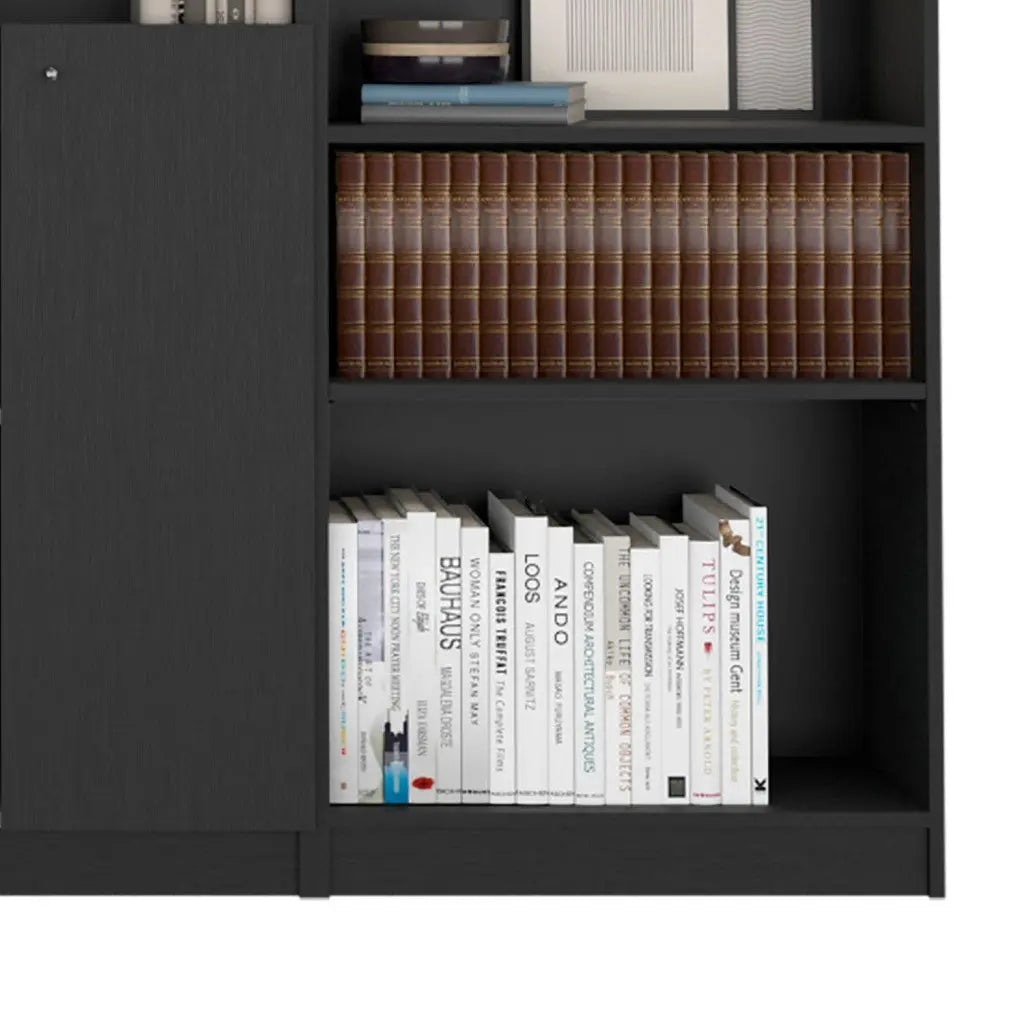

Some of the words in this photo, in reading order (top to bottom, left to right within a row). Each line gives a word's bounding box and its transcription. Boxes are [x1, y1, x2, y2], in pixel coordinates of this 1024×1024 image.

[390, 534, 401, 551] THE
[390, 552, 401, 571] NEW
[619, 548, 631, 568] THE
[390, 573, 401, 594] YORK
[470, 557, 481, 608] WOMAN
[524, 553, 540, 604] LOOS
[755, 539, 766, 597] CENTURY
[390, 595, 401, 614] CITY
[440, 556, 462, 650] BAUHAUS
[495, 570, 507, 623] FRANCOIS
[583, 561, 595, 632] COMPENDIUM
[619, 574, 631, 631] UNCOMMON
[675, 588, 684, 613] JOSEF
[702, 559, 716, 635] TULIPS
[726, 569, 742, 609] Design
[390, 617, 401, 641] NOON
[470, 612, 481, 647] ONLY
[554, 578, 568, 646] ANDO
[755, 601, 766, 643] HOUSE
[495, 628, 507, 675] TRUFFAT
[524, 622, 536, 663] AUGUST
[619, 638, 631, 666] LIFE
[675, 616, 684, 670] HOFFMANN
[729, 612, 740, 661] museum
[390, 643, 401, 673] PRAYER
[469, 651, 480, 697] STEFAN
[583, 634, 595, 717] ARCHITECTURAL
[619, 672, 631, 685] OF
[703, 668, 713, 682] BY
[729, 664, 743, 693] Gent
[390, 674, 401, 711] MEETING
[495, 680, 506, 696] The
[703, 687, 713, 723] PETER
[469, 702, 480, 726] MAY
[493, 699, 506, 743] Complete
[619, 694, 631, 737] COMMON
[495, 747, 506, 772] Films
[582, 720, 595, 773] ANTIQUES
[619, 742, 631, 792] OBJECTS
[703, 726, 713, 775] ARNOLD
